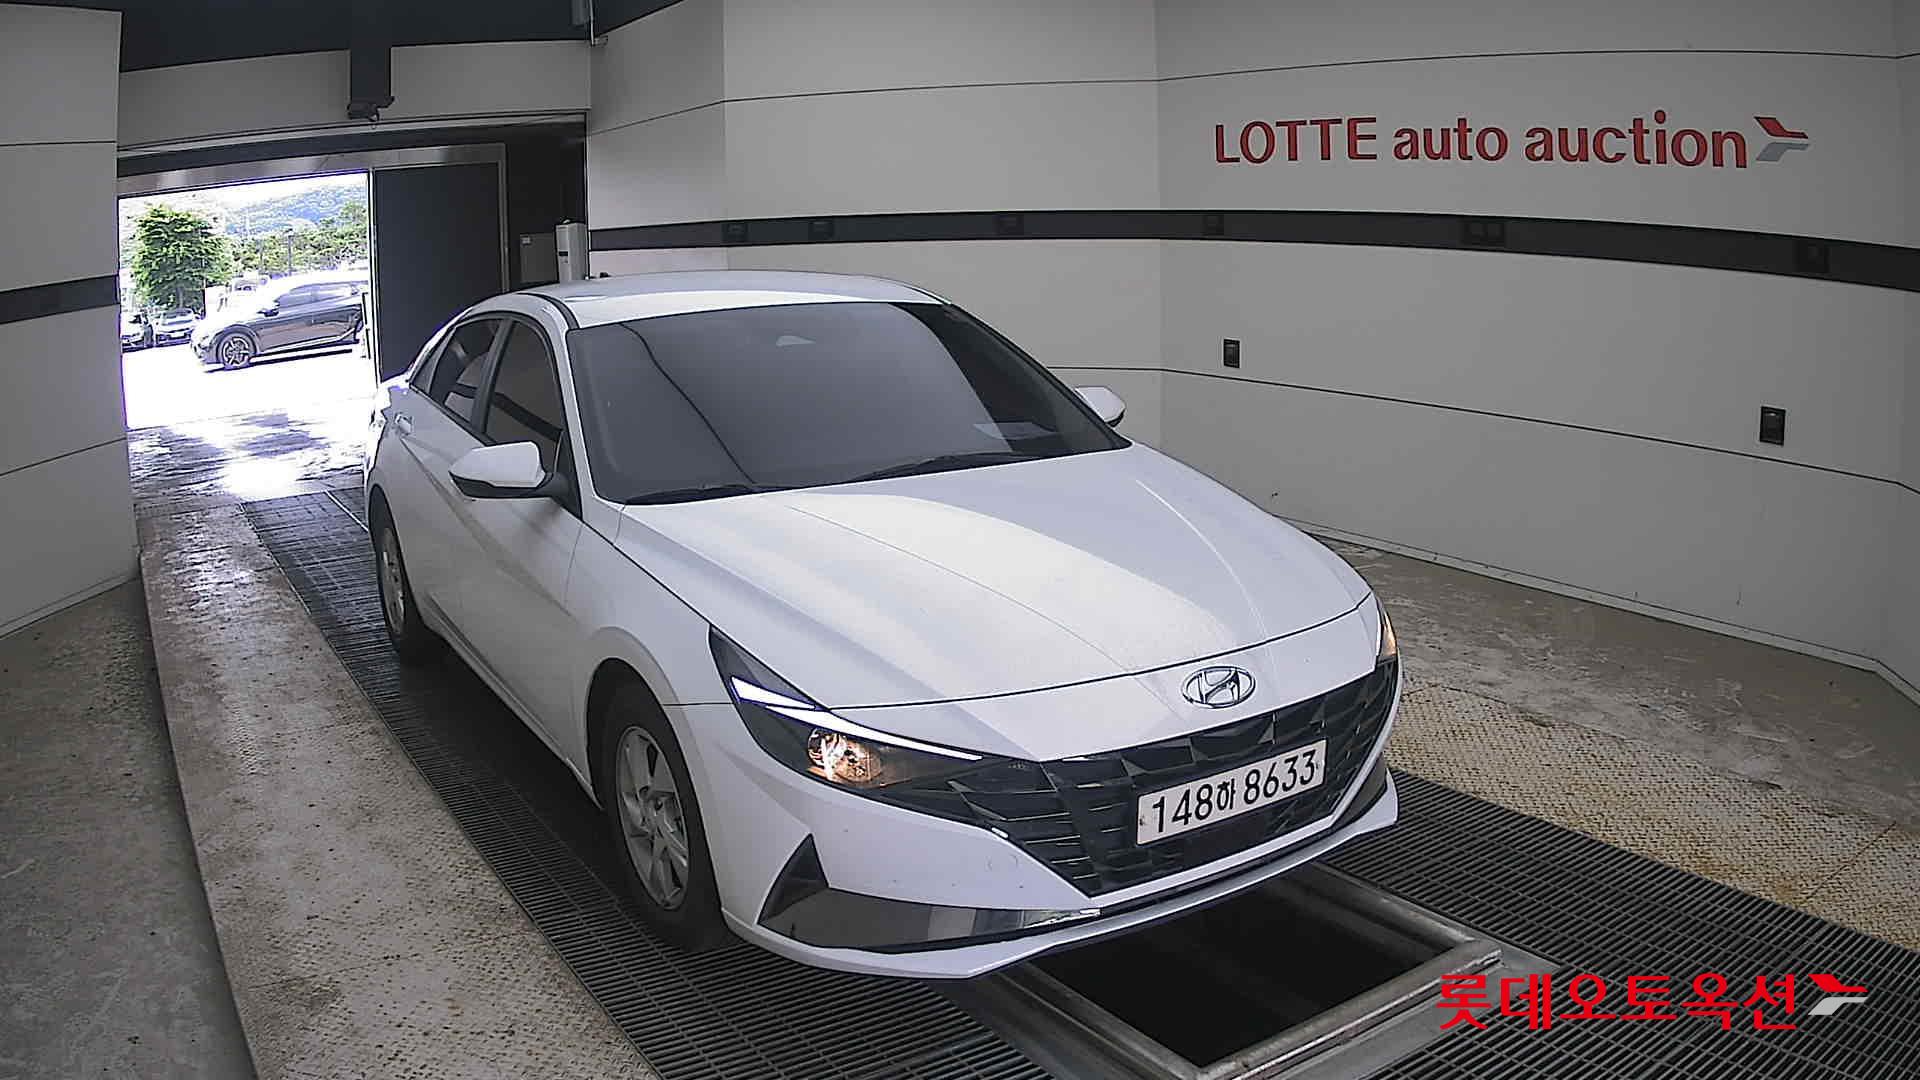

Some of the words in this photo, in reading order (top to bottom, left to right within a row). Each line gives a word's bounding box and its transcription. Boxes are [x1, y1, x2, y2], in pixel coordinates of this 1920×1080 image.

[1215, 116, 1377, 164] LOTTE
[1392, 117, 1508, 163] auto
[1524, 110, 1748, 169] auction
[1152, 778, 1235, 833] 148하
[1243, 749, 1316, 805] 8633
